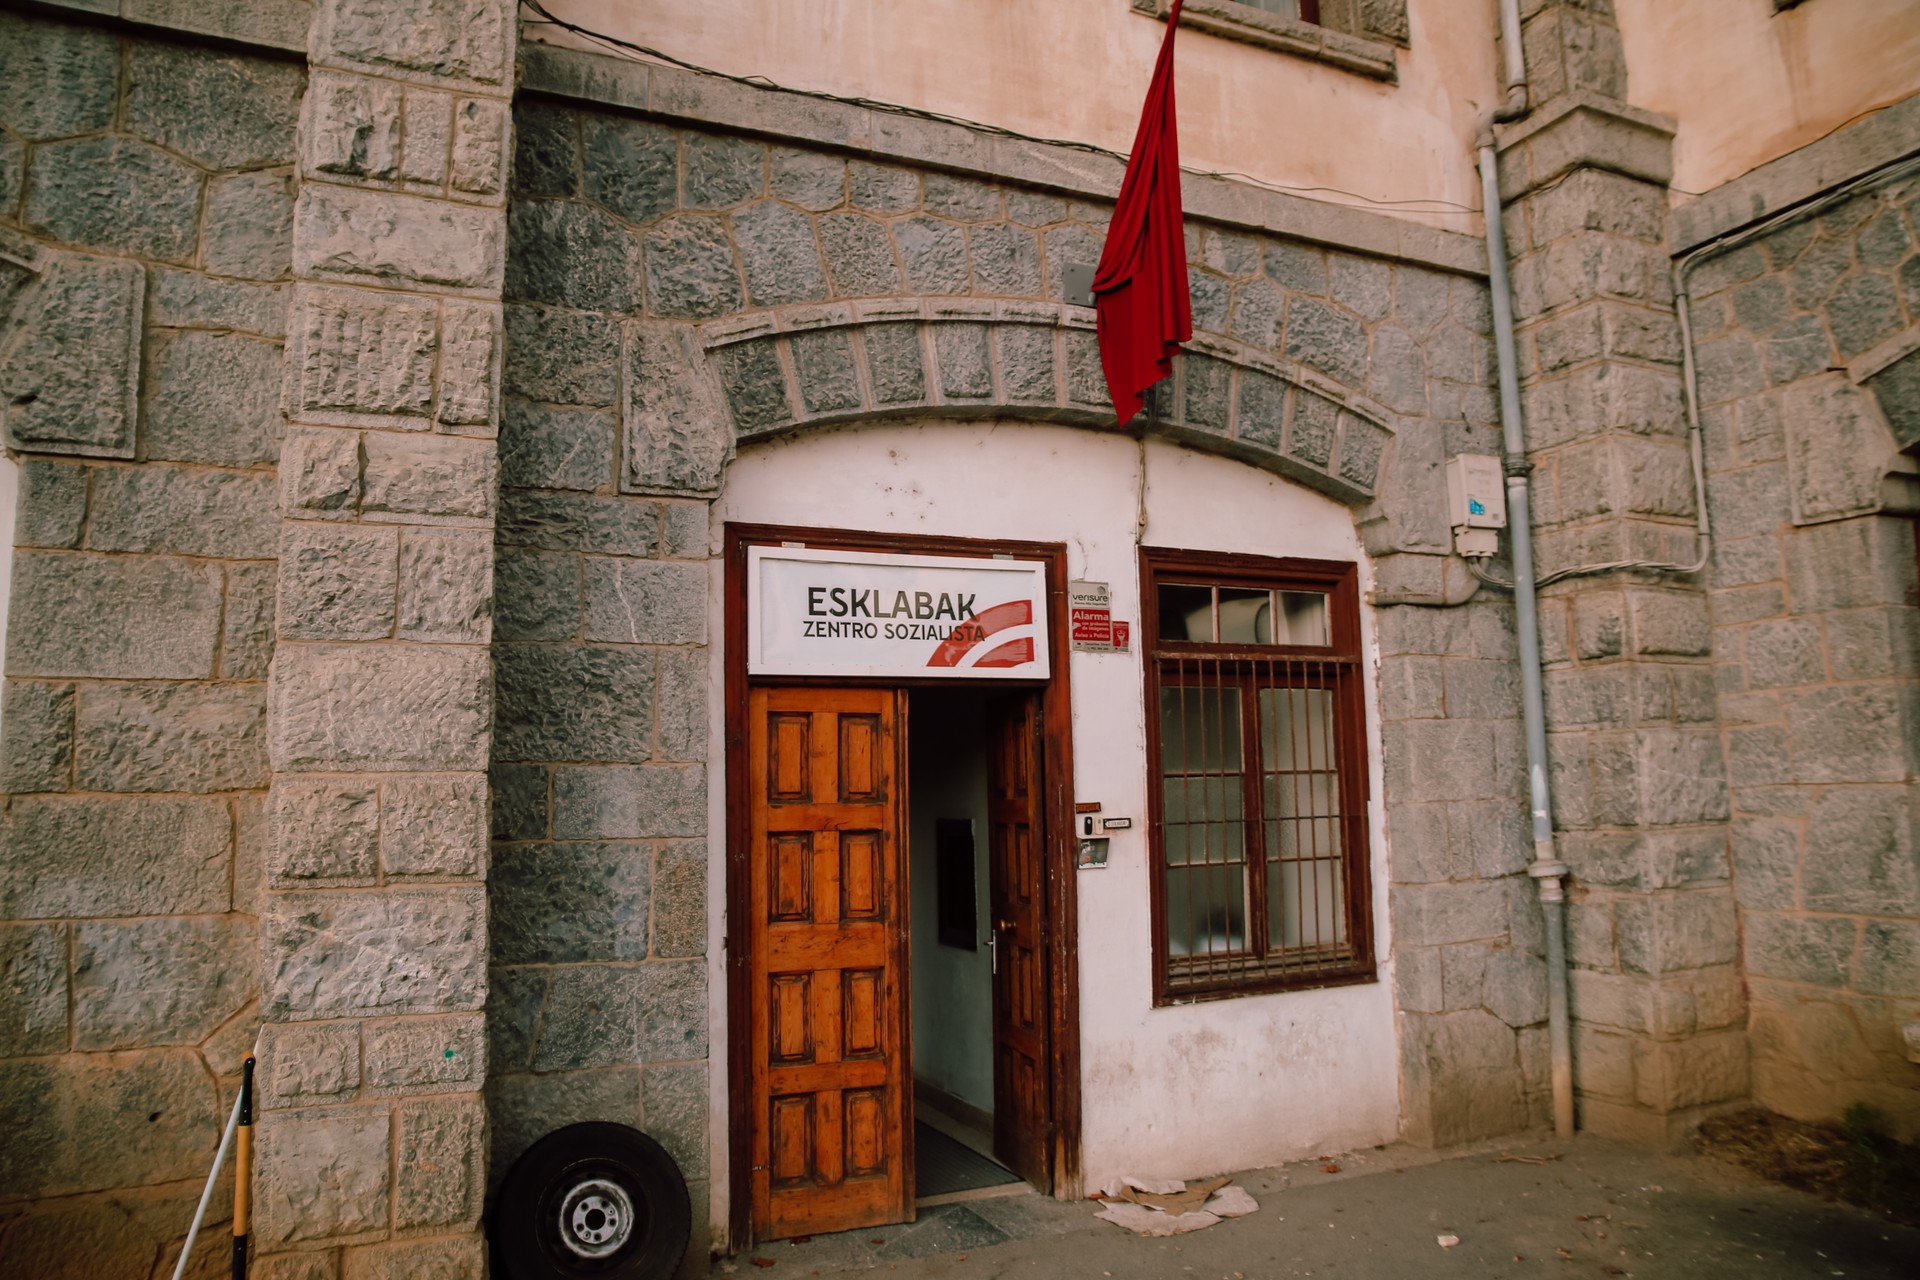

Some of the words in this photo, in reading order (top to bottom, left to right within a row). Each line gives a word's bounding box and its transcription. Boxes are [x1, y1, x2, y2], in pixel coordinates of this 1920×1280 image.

[807, 586, 977, 621] ESKLABAK
[1072, 594, 1108, 602] verisure
[1073, 611, 1109, 621] Alarma
[803, 621, 878, 639] ZENTRO
[884, 623, 986, 642] SOZIALISTA
